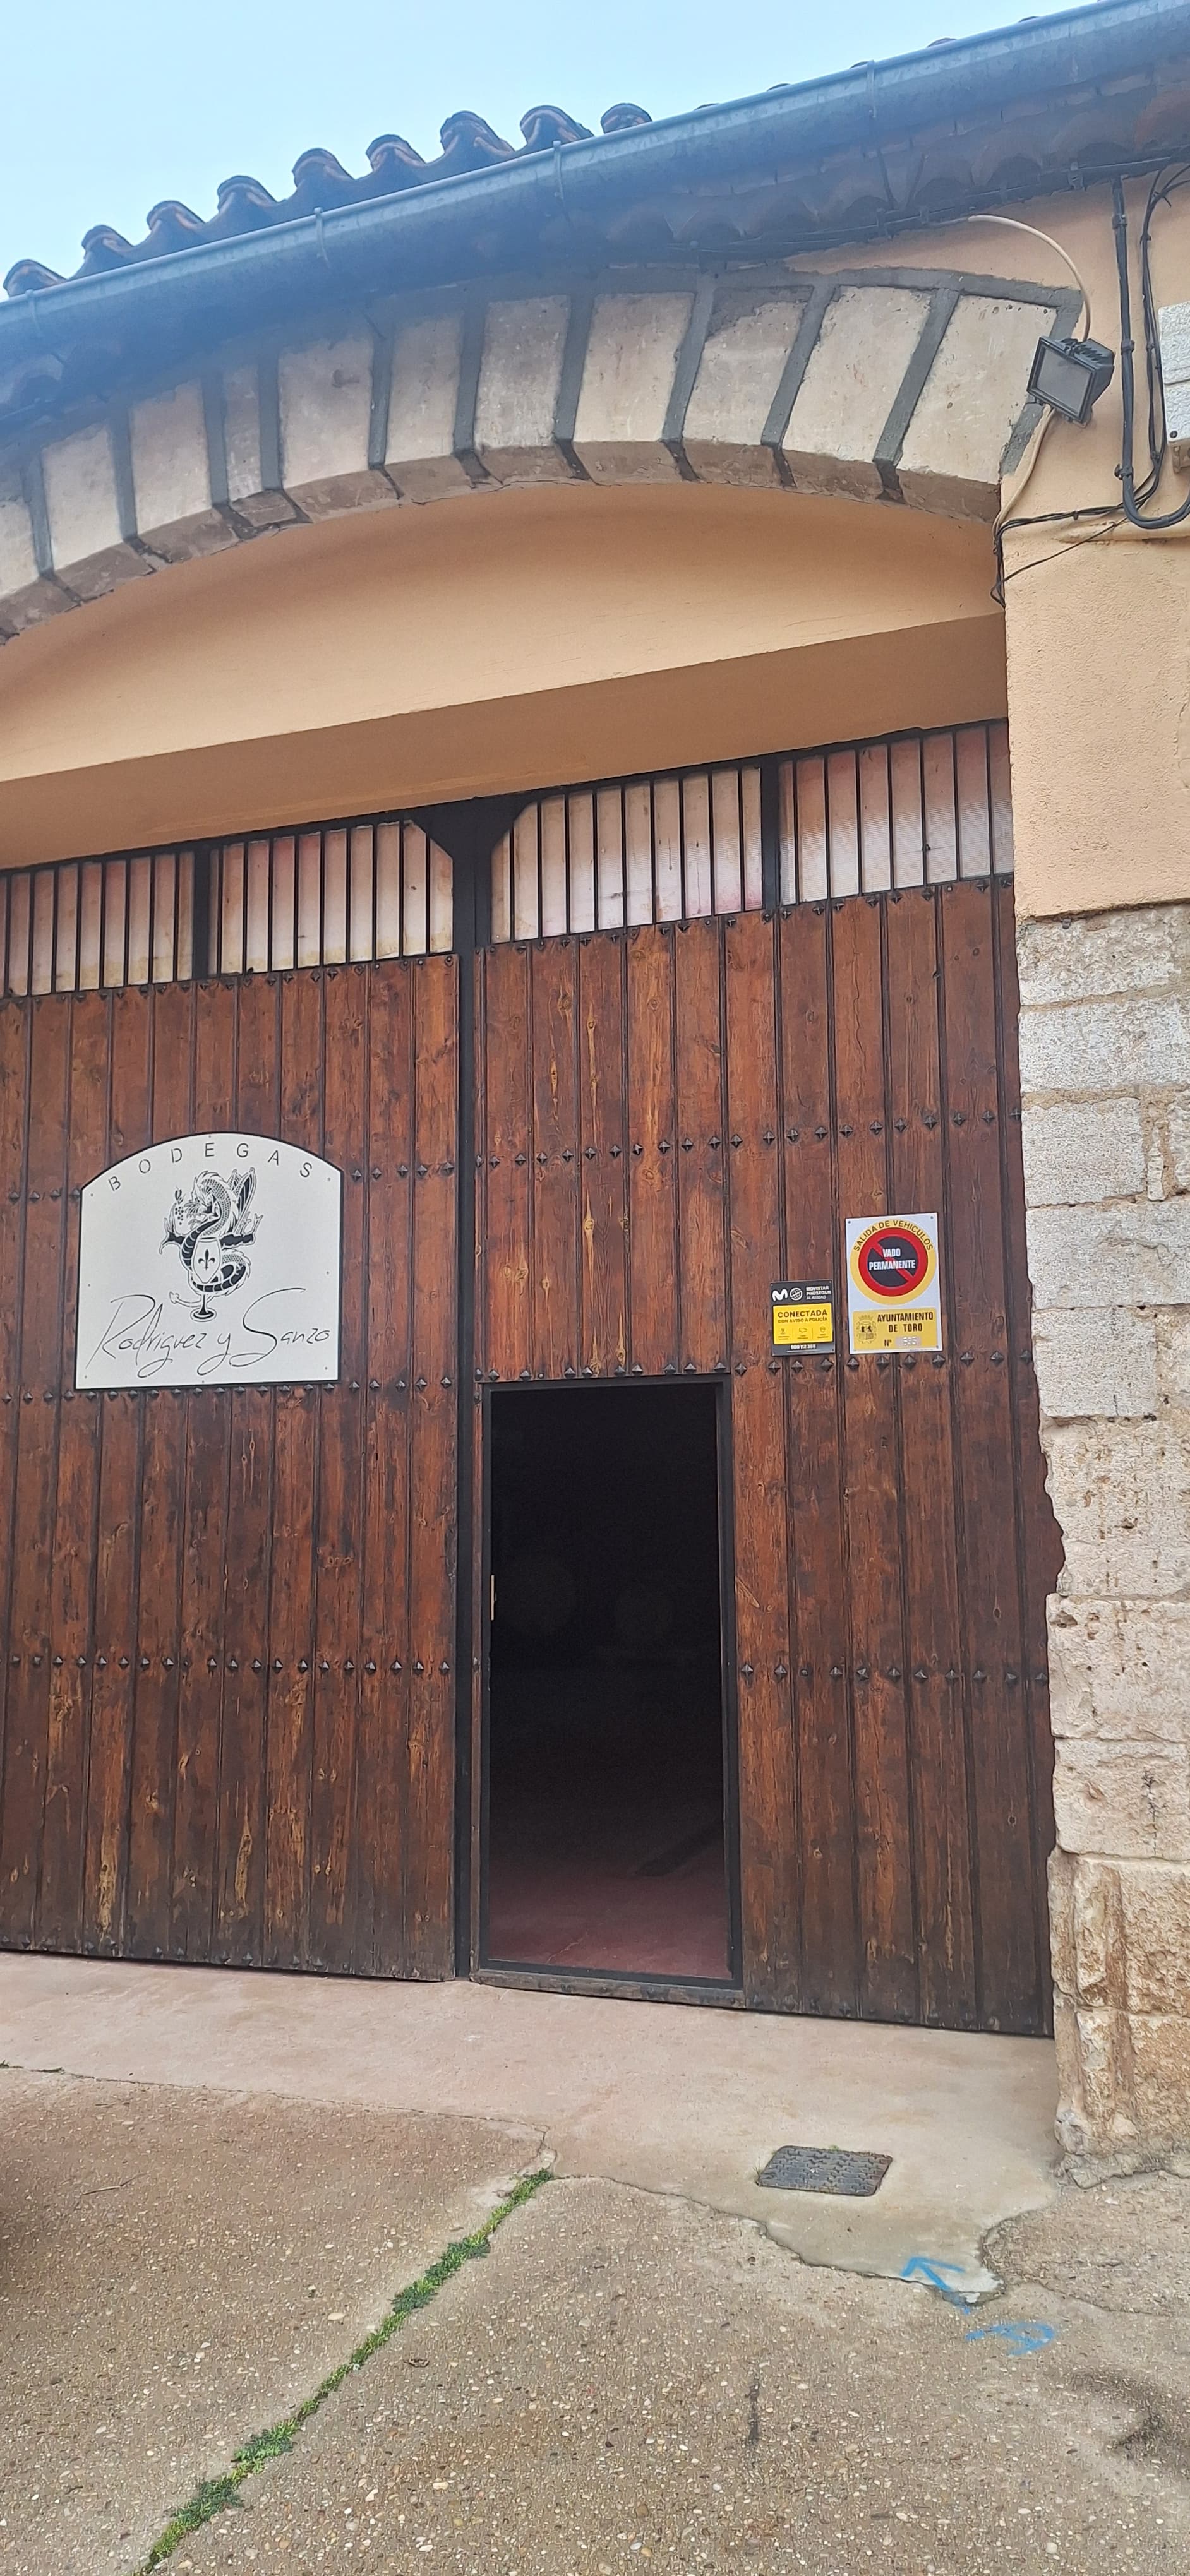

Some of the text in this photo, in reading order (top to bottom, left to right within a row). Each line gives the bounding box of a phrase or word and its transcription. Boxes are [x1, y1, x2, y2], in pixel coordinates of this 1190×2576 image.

[108, 1142, 313, 1192] BODEGAS
[853, 1220, 933, 1251] SALIDA DE VEHICULOS
[882, 1248, 901, 1257] VADO
[868, 1260, 916, 1270] PERMANENTE
[778, 1309, 828, 1318] CONECTADA
[877, 1312, 934, 1322] AYUNTAMIENTO
[197, 1332, 232, 1376] y
[229, 1287, 330, 1368] Sanzo
[889, 1323, 922, 1333] DE TORO
